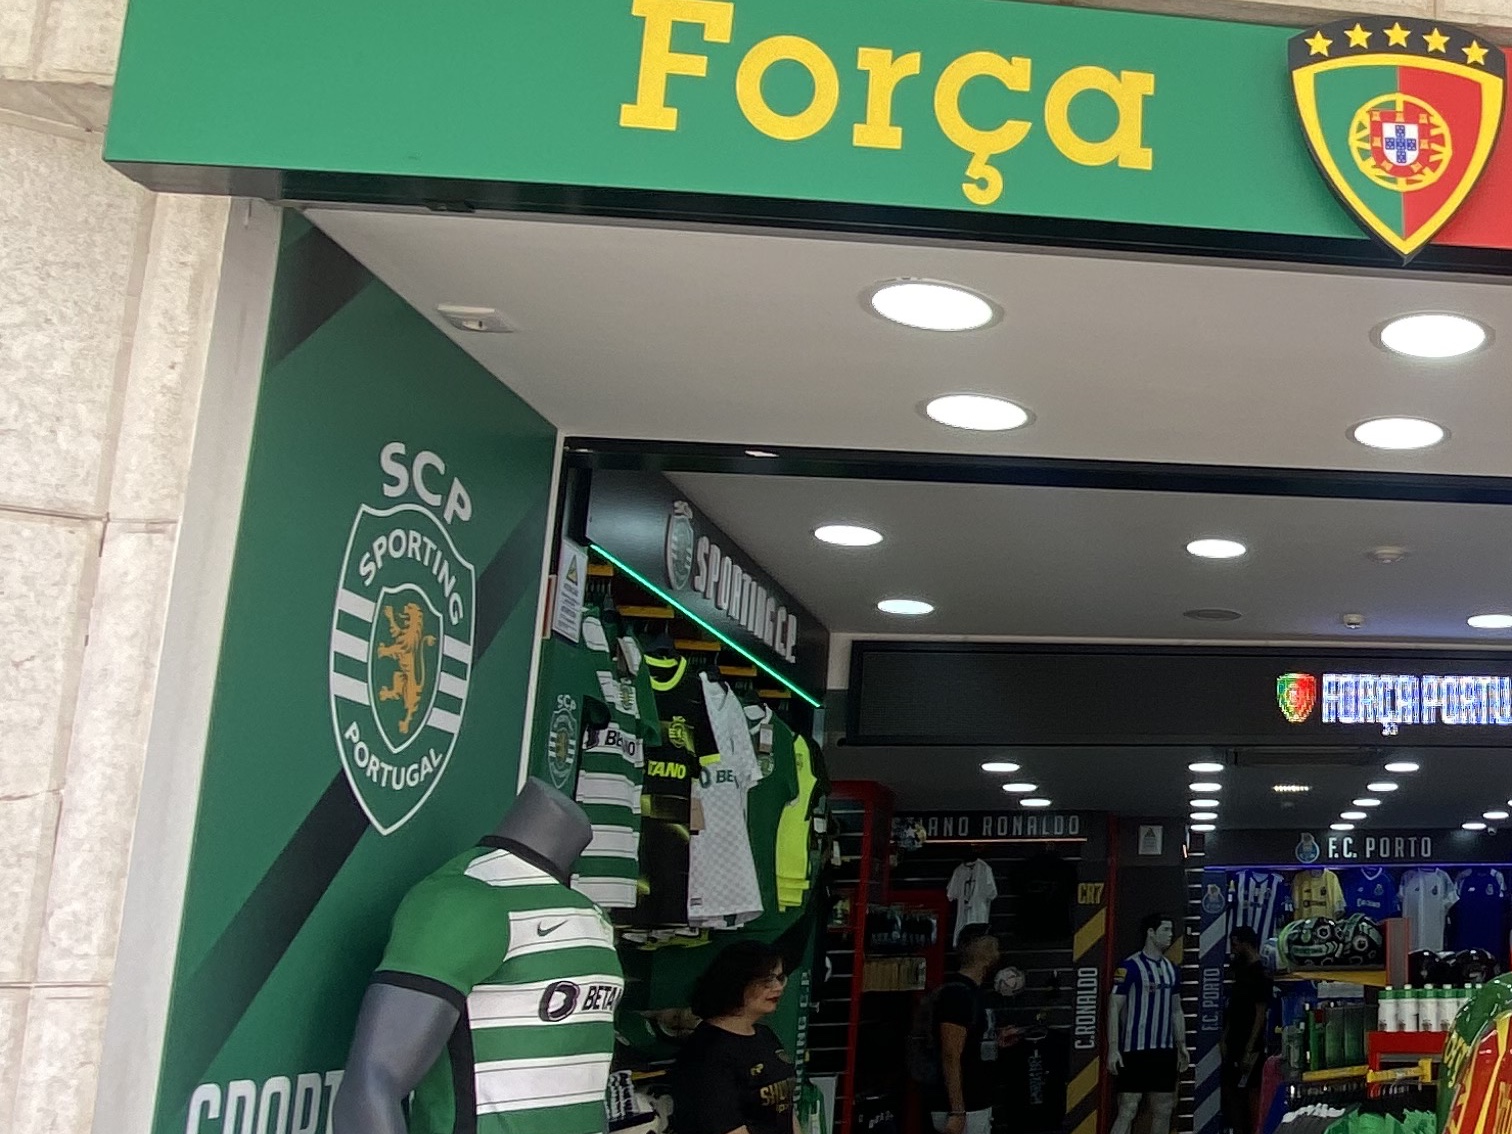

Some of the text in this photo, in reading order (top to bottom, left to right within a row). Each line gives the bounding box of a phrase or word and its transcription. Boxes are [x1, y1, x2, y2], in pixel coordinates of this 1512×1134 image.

[619, 0, 1157, 207] Força
[379, 441, 473, 525] SCP
[359, 528, 464, 626] SPORTING
[343, 721, 443, 791] PORTUGAL
[982, 814, 1080, 837] RONALDO
[1328, 836, 1432, 859] F.C. PORTO
